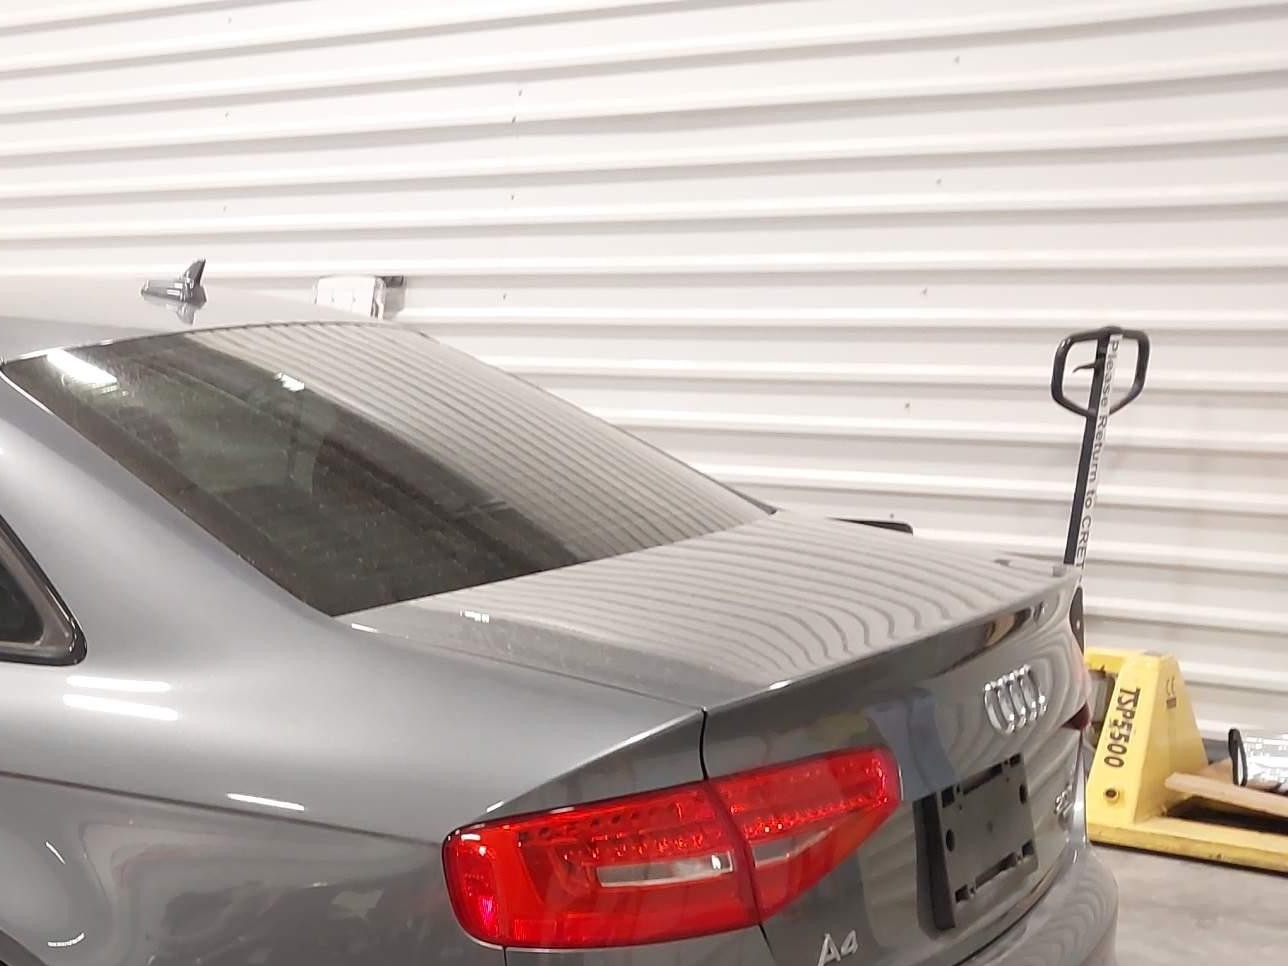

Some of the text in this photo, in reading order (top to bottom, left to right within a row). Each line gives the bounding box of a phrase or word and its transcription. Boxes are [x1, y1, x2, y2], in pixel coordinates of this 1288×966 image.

[1100, 339, 1119, 407] Please
[1089, 415, 1108, 482] Return
[1085, 489, 1095, 509] to
